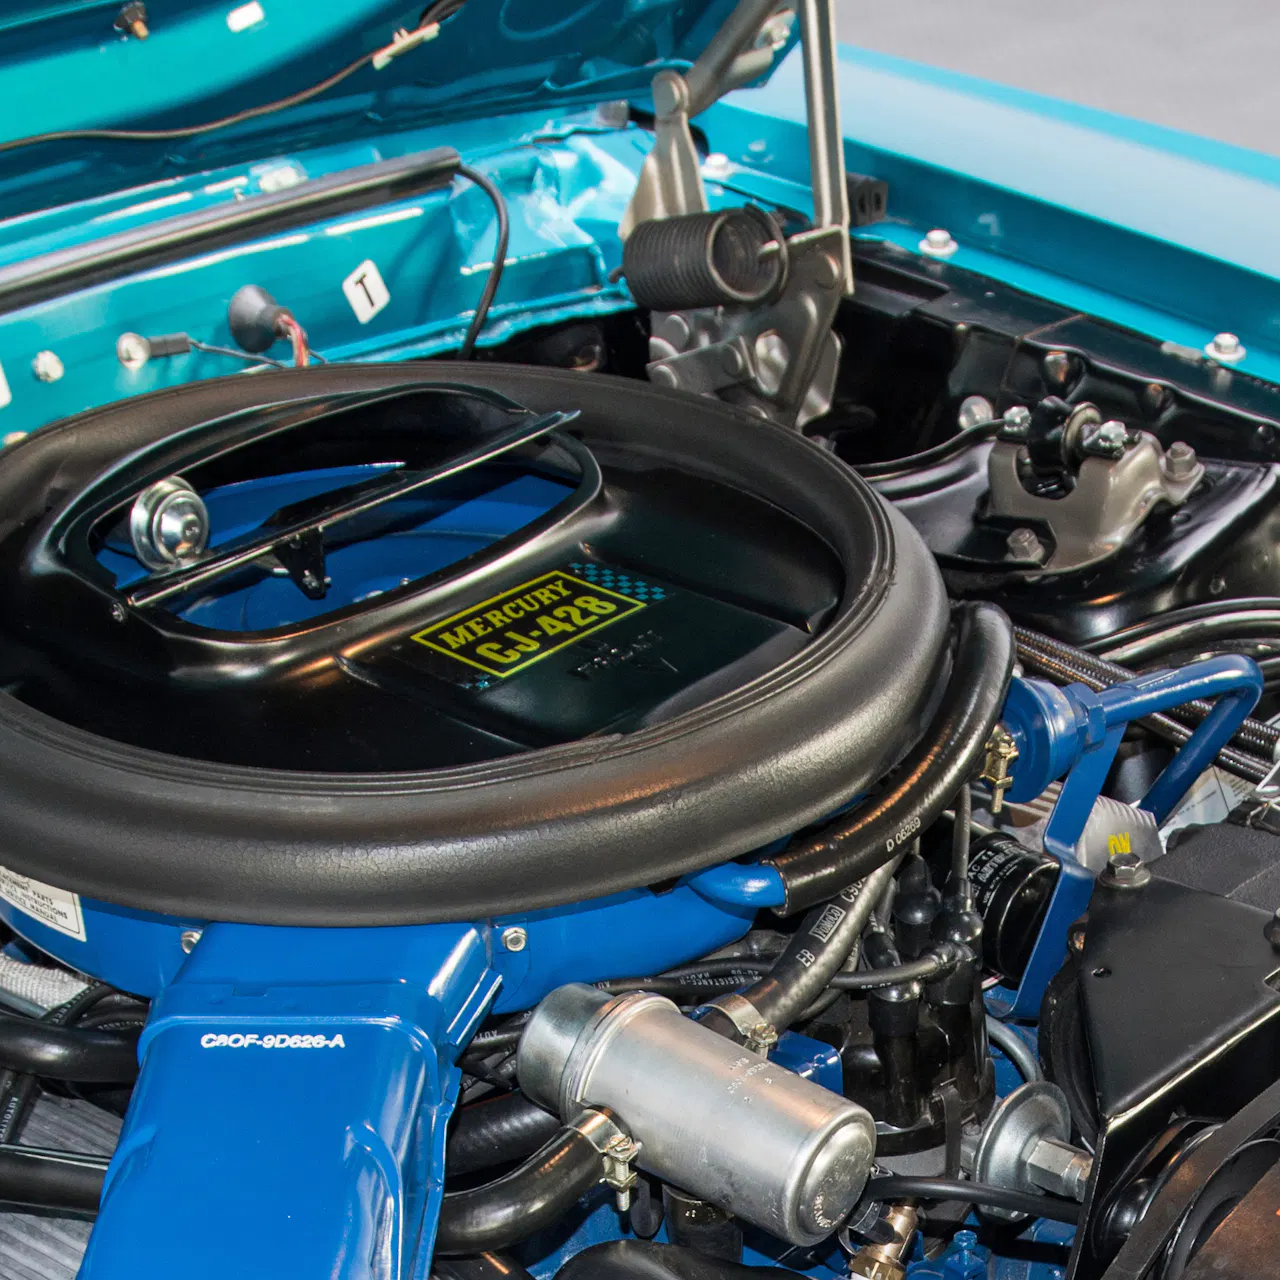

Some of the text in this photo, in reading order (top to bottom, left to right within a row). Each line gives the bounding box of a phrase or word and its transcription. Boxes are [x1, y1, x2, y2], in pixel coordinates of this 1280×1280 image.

[355, 272, 374, 308] T
[438, 580, 572, 649] MERCURY
[885, 815, 921, 852] D 06269
[794, 946, 817, 968] EB
